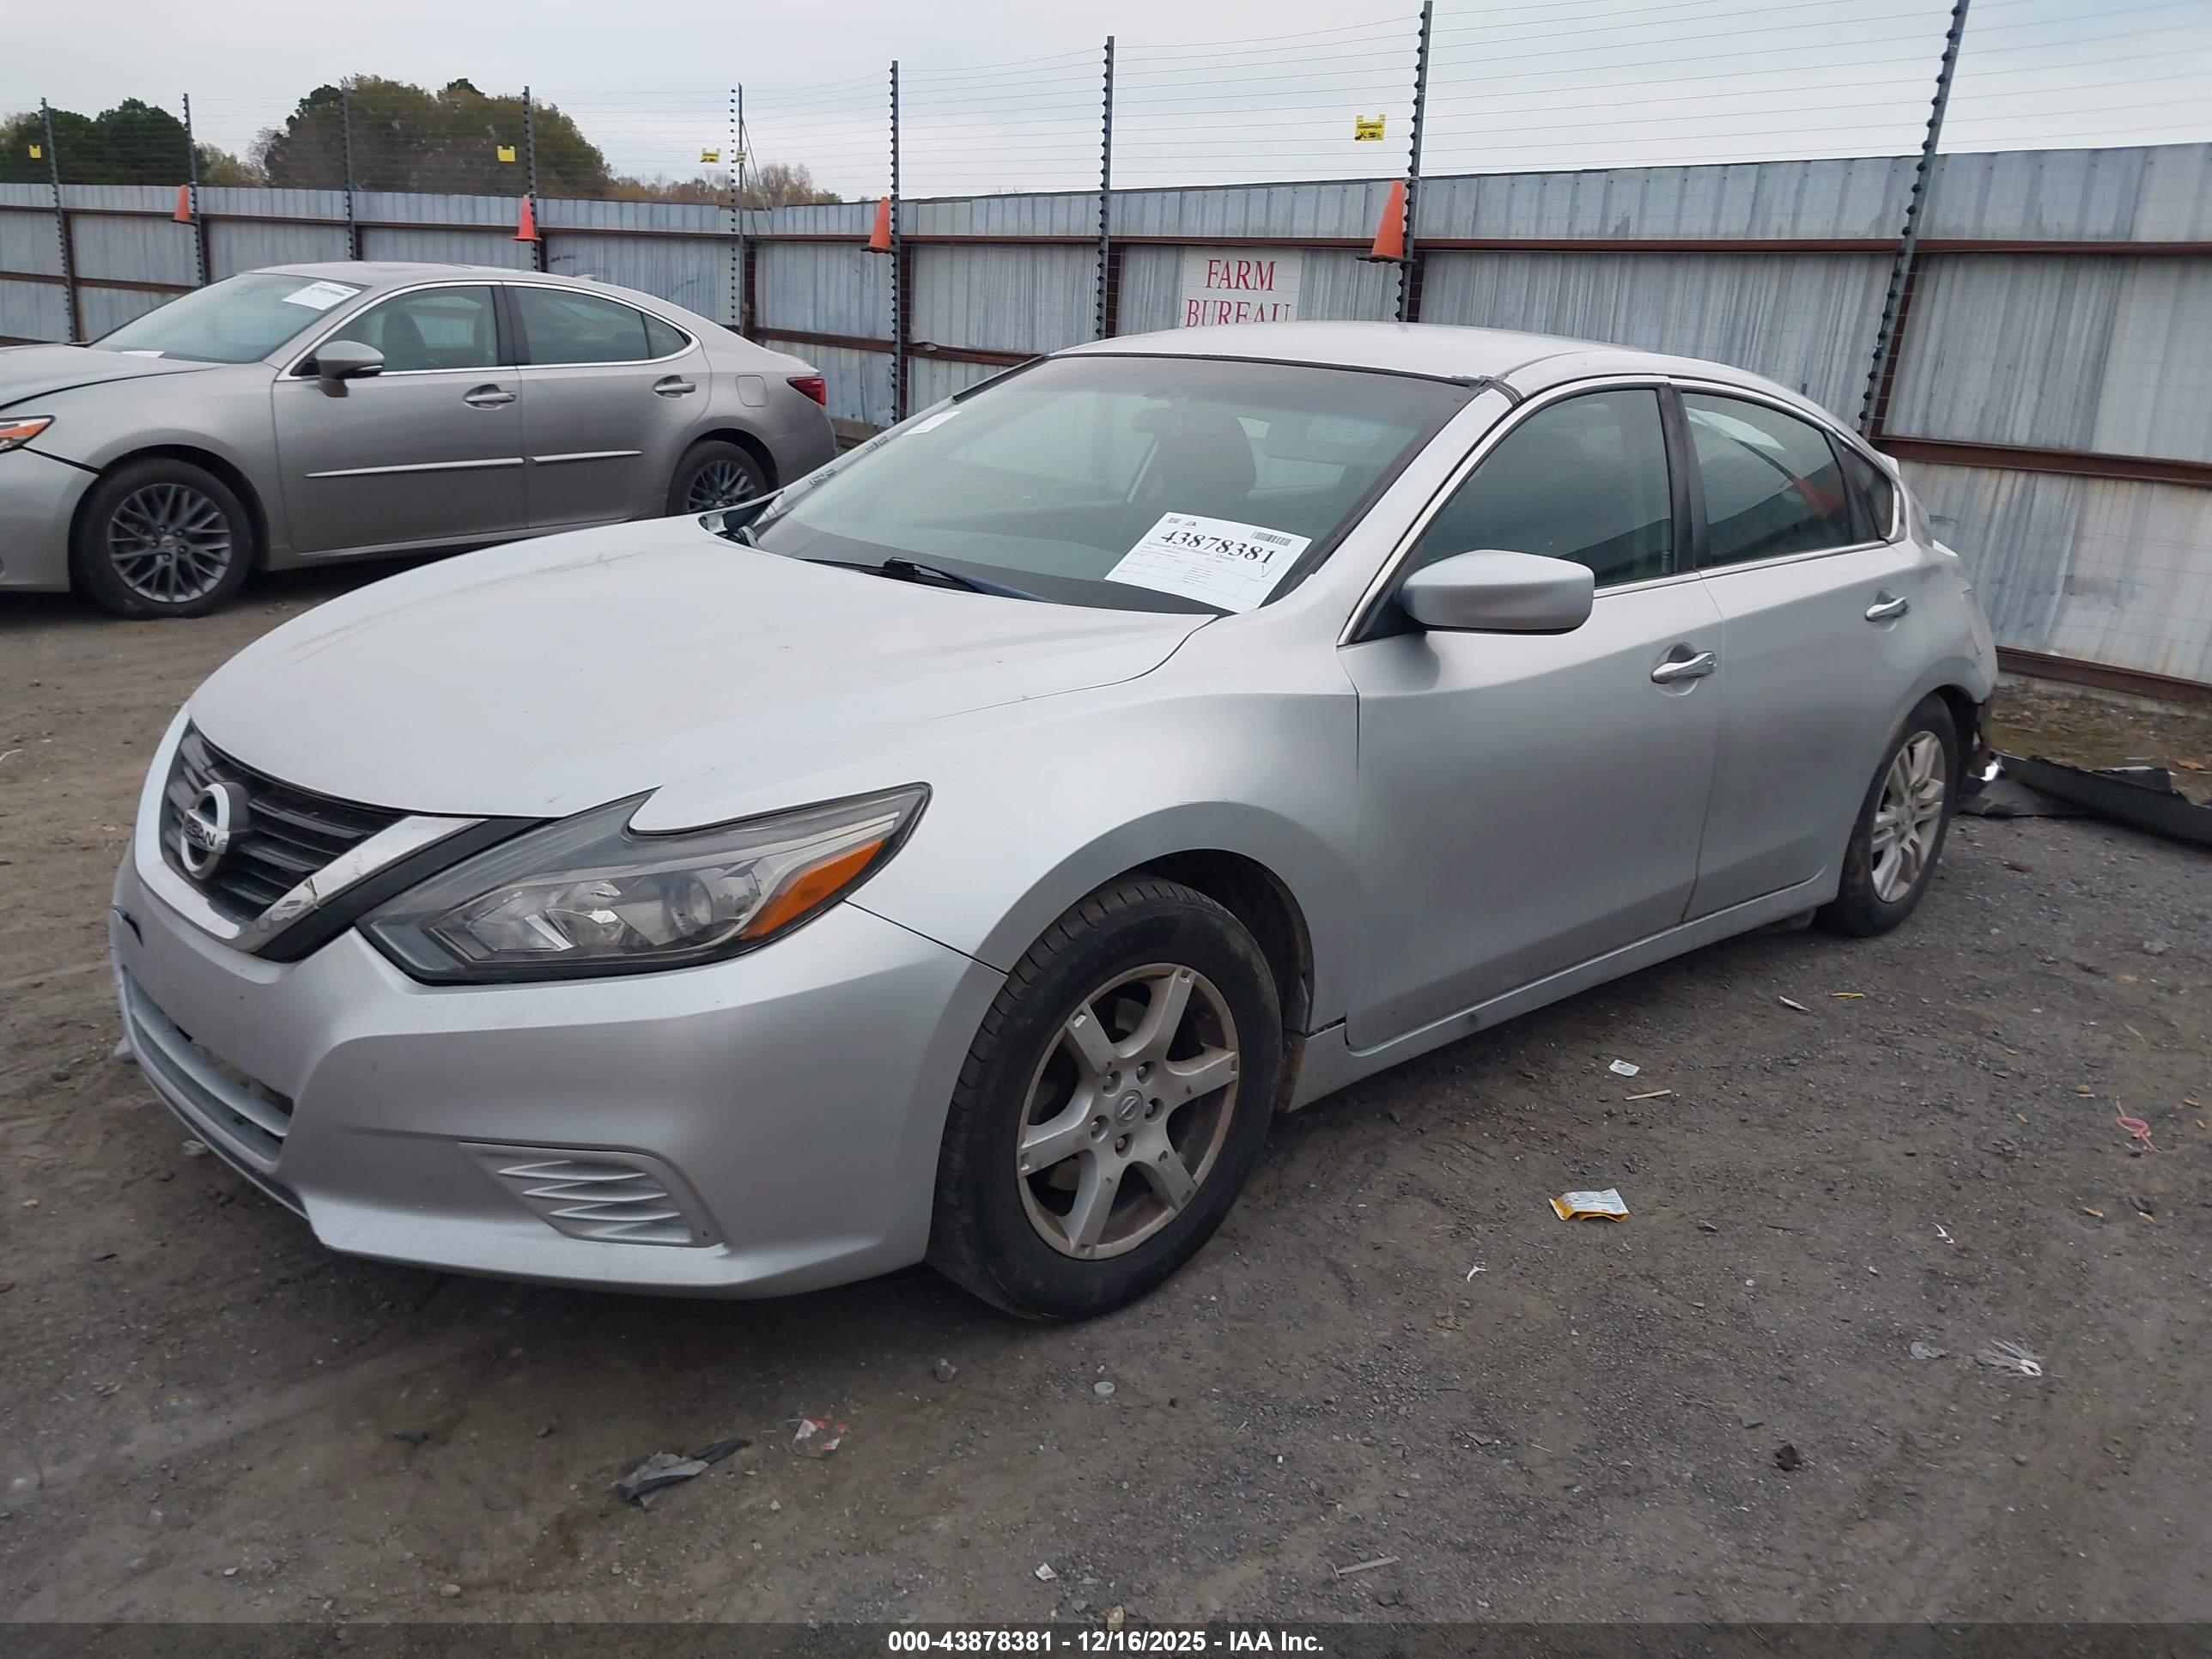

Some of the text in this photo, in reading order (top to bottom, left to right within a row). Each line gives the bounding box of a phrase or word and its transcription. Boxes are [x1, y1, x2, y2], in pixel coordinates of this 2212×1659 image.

[1205, 259, 1277, 291] FARM
[1185, 299, 1291, 327] BUREAU
[1160, 530, 1278, 565] 43878381
